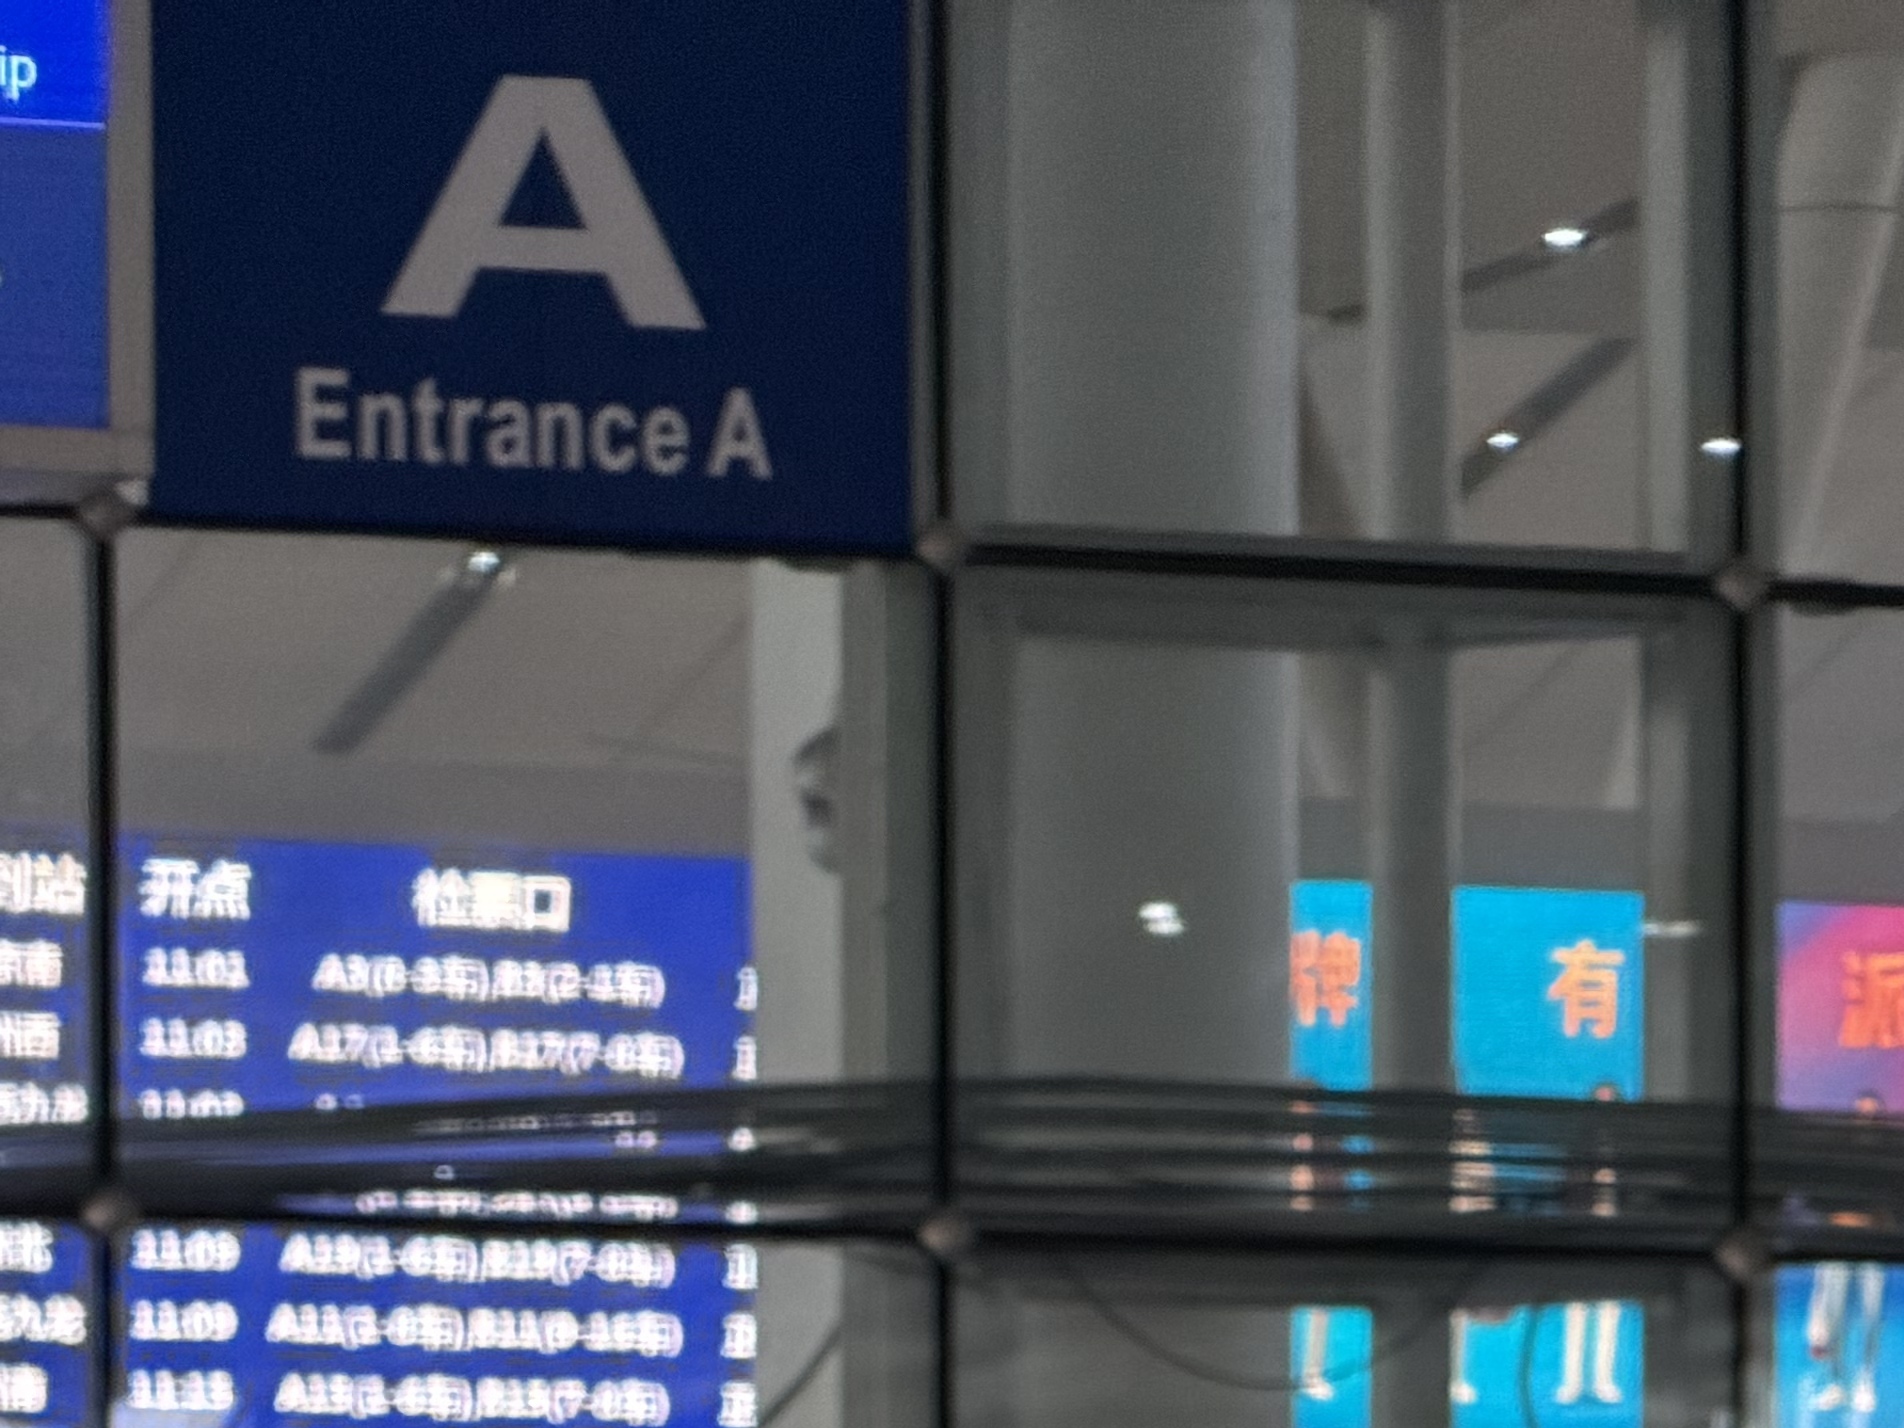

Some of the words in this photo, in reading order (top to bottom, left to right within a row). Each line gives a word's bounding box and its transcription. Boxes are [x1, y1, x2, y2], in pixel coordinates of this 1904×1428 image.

[383, 76, 704, 329] A
[298, 368, 688, 474] Entrance
[709, 389, 770, 477] A
[1547, 938, 1626, 1038] 有
